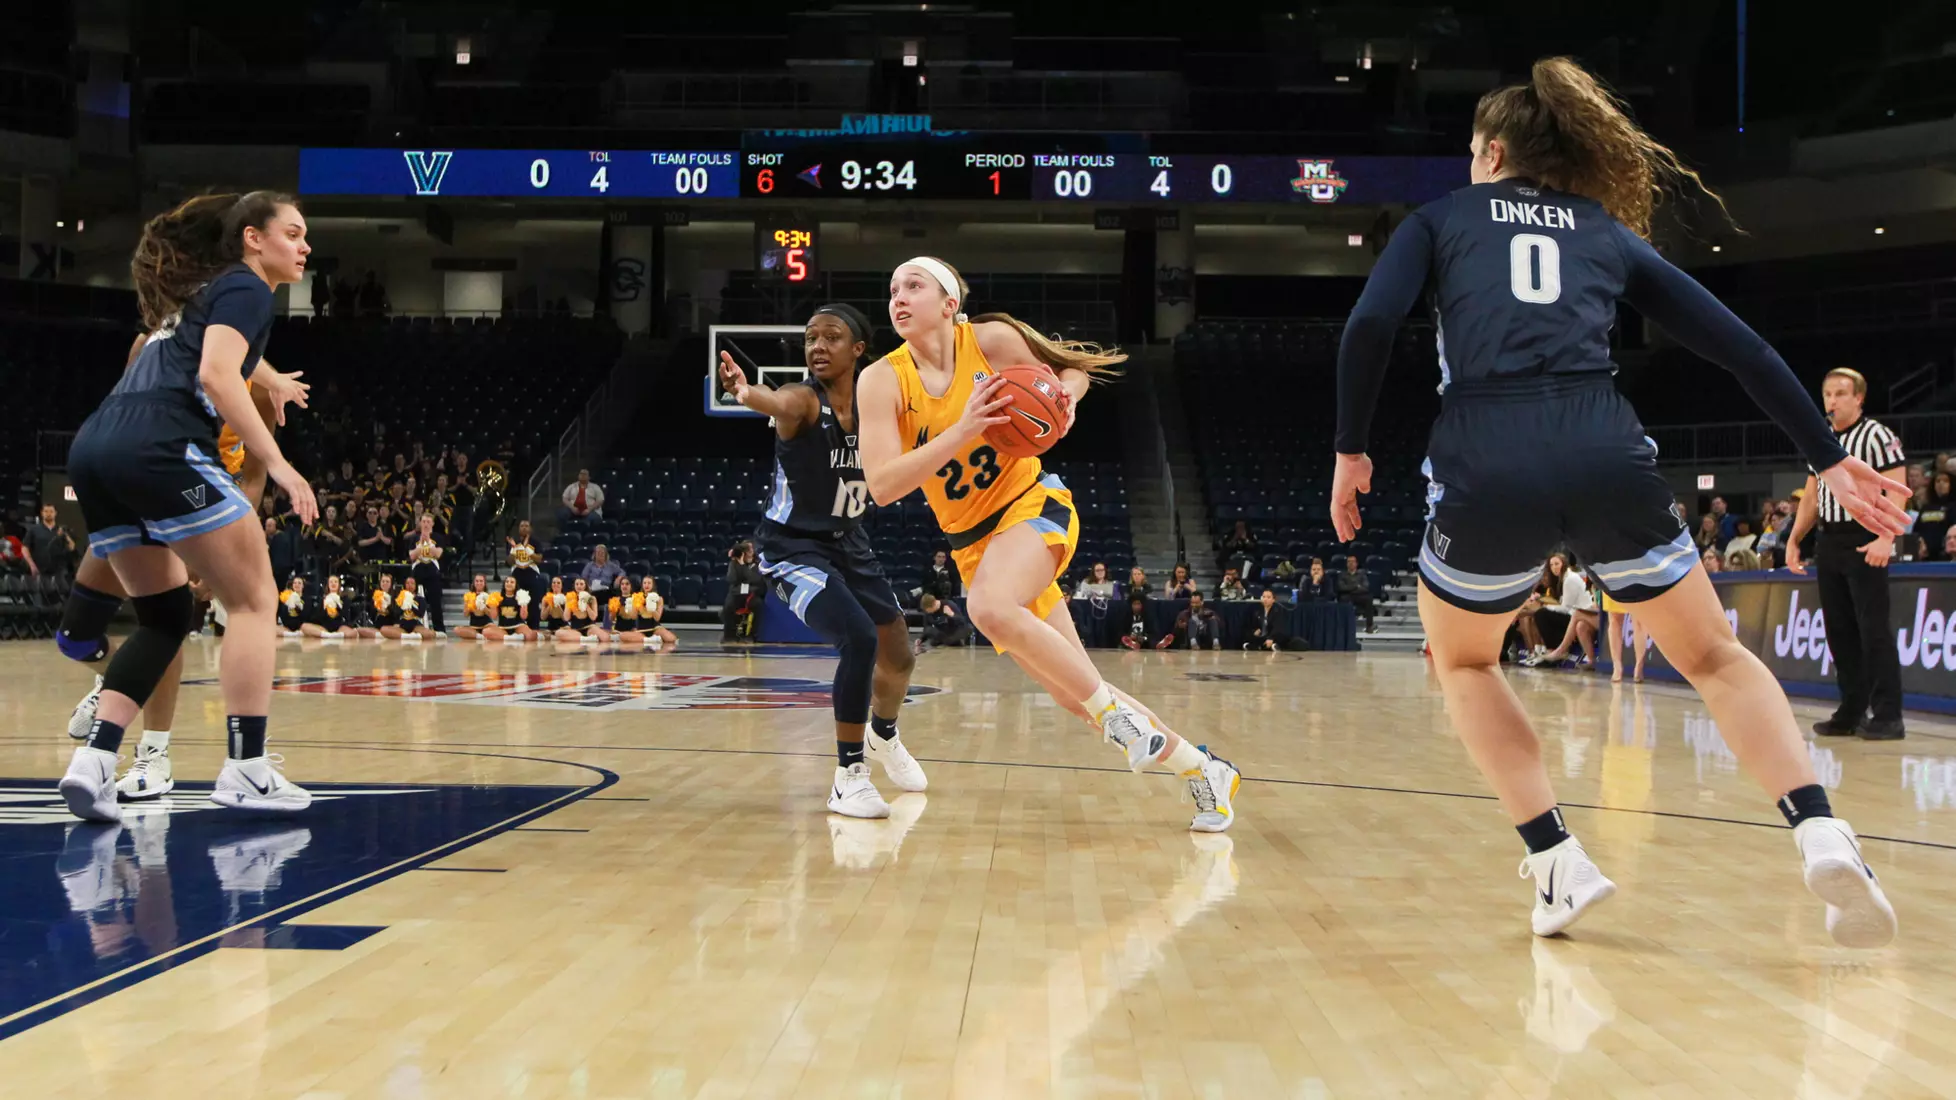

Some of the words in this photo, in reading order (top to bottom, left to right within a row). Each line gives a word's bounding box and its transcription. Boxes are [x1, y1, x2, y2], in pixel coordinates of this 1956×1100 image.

[588, 151, 612, 163] TOL
[651, 153, 687, 166] TEAM
[689, 153, 732, 166] FOULS
[747, 153, 784, 166] SHOT
[965, 153, 1026, 168] PERIOD
[1033, 154, 1069, 167] TEAM
[1071, 154, 1115, 167] FOULS
[1148, 155, 1173, 168] TOL
[530, 158, 550, 189] 0
[589, 166, 610, 193] 4
[675, 167, 708, 194] 00
[757, 168, 775, 194] 6
[841, 160, 917, 190] 9:34
[989, 171, 1000, 195] 1
[1054, 170, 1092, 197] 00
[1150, 170, 1171, 197] 4
[1211, 163, 1232, 194] 0
[1490, 199, 1576, 230] ONKEN
[774, 230, 811, 249] 9:34
[786, 249, 807, 281] 5
[1510, 233, 1561, 304] 0
[936, 445, 1001, 500] 23
